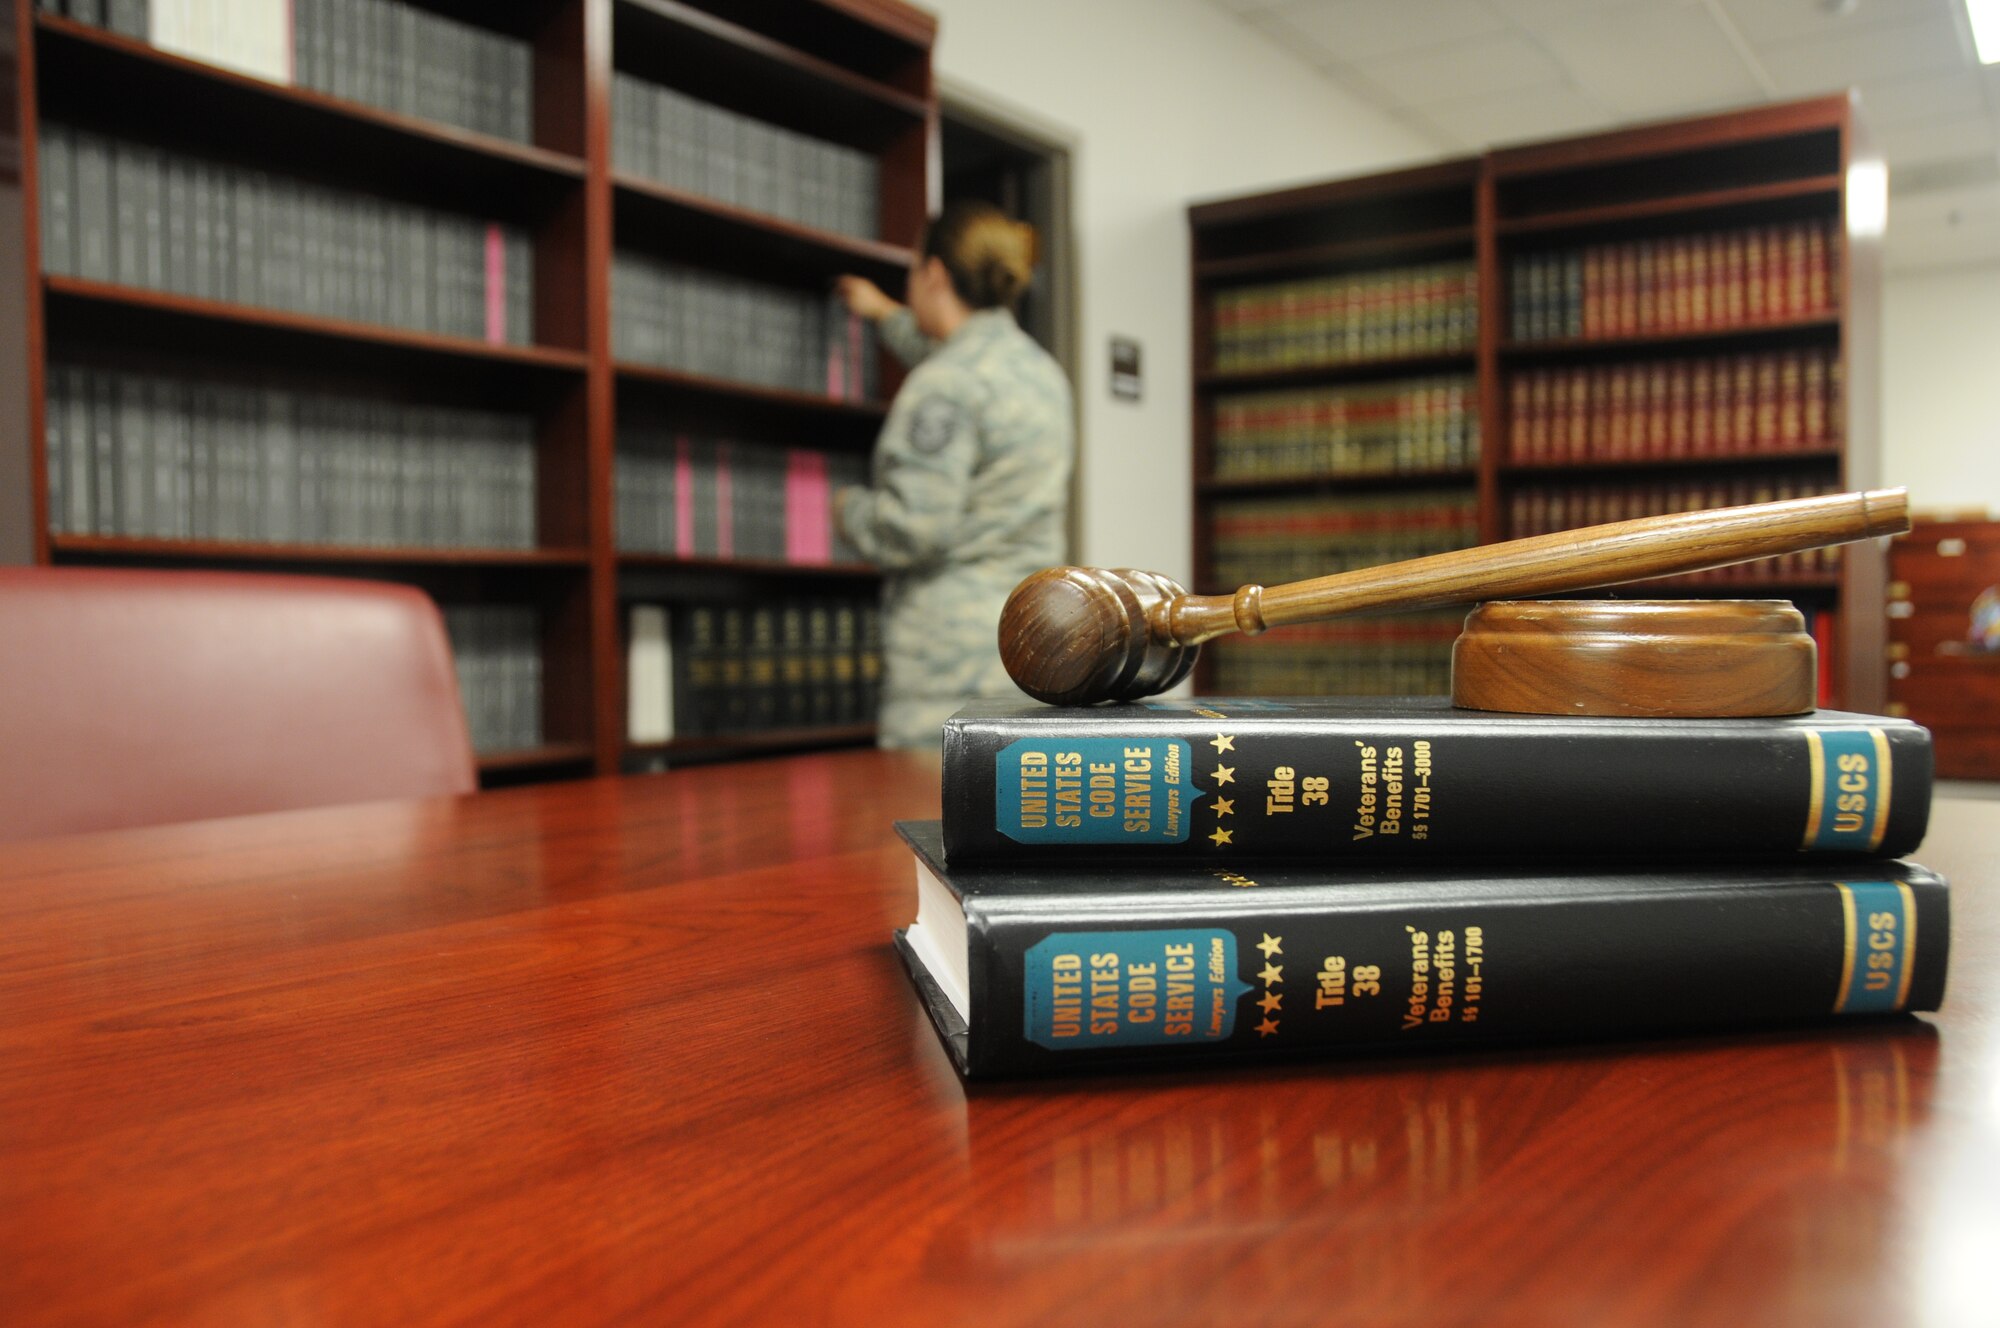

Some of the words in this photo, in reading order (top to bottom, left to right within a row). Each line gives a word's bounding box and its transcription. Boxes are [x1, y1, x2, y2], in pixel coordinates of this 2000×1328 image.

[1021, 751, 1048, 828] UNITED
[1055, 752, 1082, 827] STATES
[1089, 763, 1116, 817] CODE
[1123, 746, 1152, 832] SERVICE
[1164, 743, 1180, 785] Edition
[1266, 766, 1295, 816] Title
[1302, 776, 1330, 806] 38
[1379, 746, 1403, 835] Benefits
[1833, 753, 1870, 833] USCS
[1163, 789, 1182, 837] Lawyers
[1208, 937, 1225, 984] Edition
[1315, 955, 1346, 1011] Title
[1352, 965, 1381, 998] 38
[1429, 929, 1456, 1023] Benefits
[1864, 911, 1897, 990] USCS
[1052, 954, 1082, 1037] UNITED
[1090, 952, 1120, 1035] STATES
[1128, 962, 1157, 1024] CODE
[1164, 942, 1195, 1036] SERVICE
[1206, 988, 1228, 1037] Lawyers
